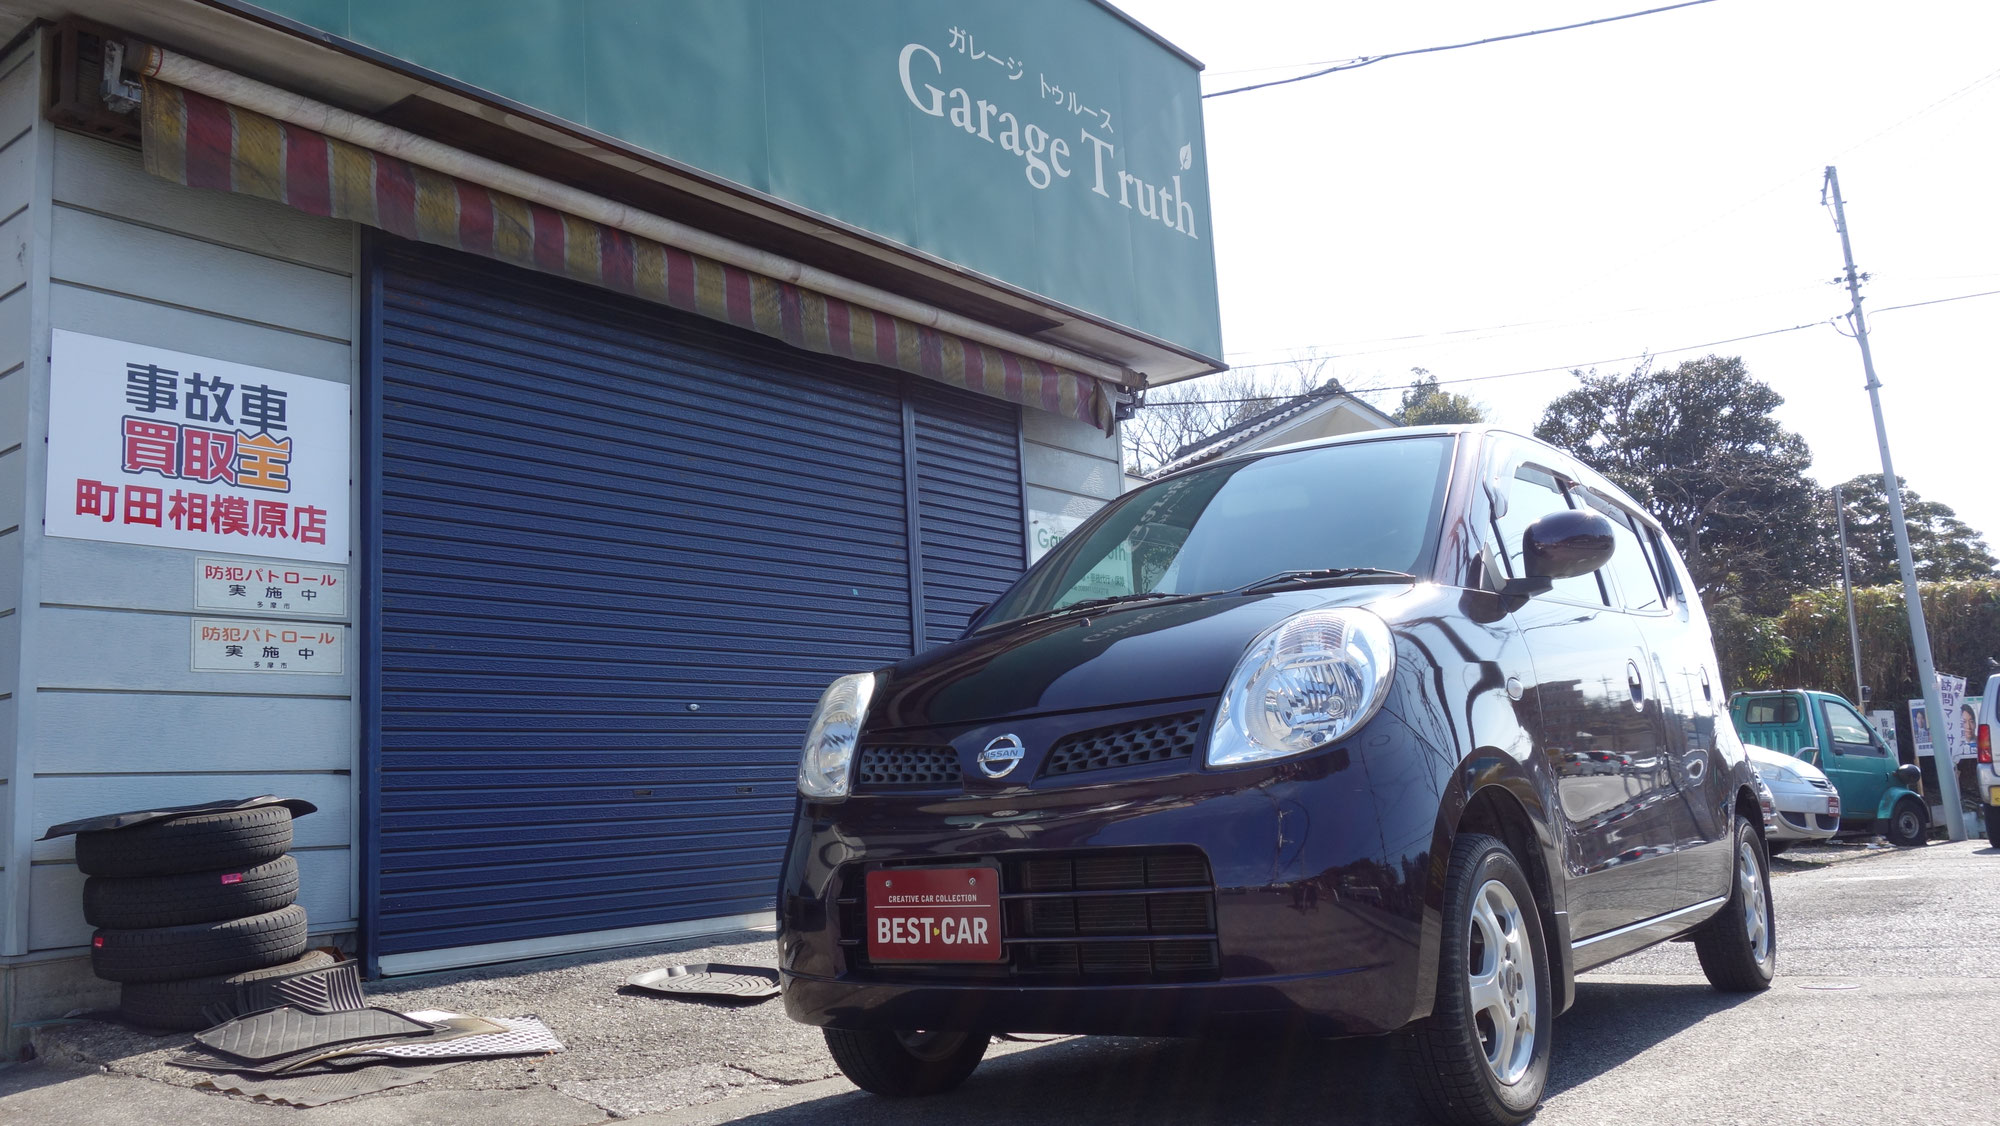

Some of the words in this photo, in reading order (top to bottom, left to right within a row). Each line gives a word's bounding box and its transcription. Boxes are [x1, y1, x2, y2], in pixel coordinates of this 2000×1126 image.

[948, 25, 1024, 80] ガレージ
[1039, 72, 1114, 134] トゥルース
[898, 43, 1071, 189] Garage
[1081, 128, 1199, 239] Truth
[125, 362, 288, 433] 事故車
[75, 478, 327, 545] 町田相模原店
[1037, 527, 1063, 549] Gar
[205, 565, 337, 586] 防犯パトロール
[228, 584, 317, 601] 実施中
[257, 601, 290, 609] 多摩市
[201, 626, 335, 645] 防犯パトロール
[225, 645, 314, 660] 実施中
[254, 661, 287, 669] 多摩市
[1941, 679, 1955, 757] 訪問マッサー
[983, 749, 1018, 759] NISSAN
[888, 895, 919, 903] CREATIVE
[935, 894, 977, 902] COLLECTION
[877, 917, 935, 944] BEST
[941, 917, 989, 944] CAR
